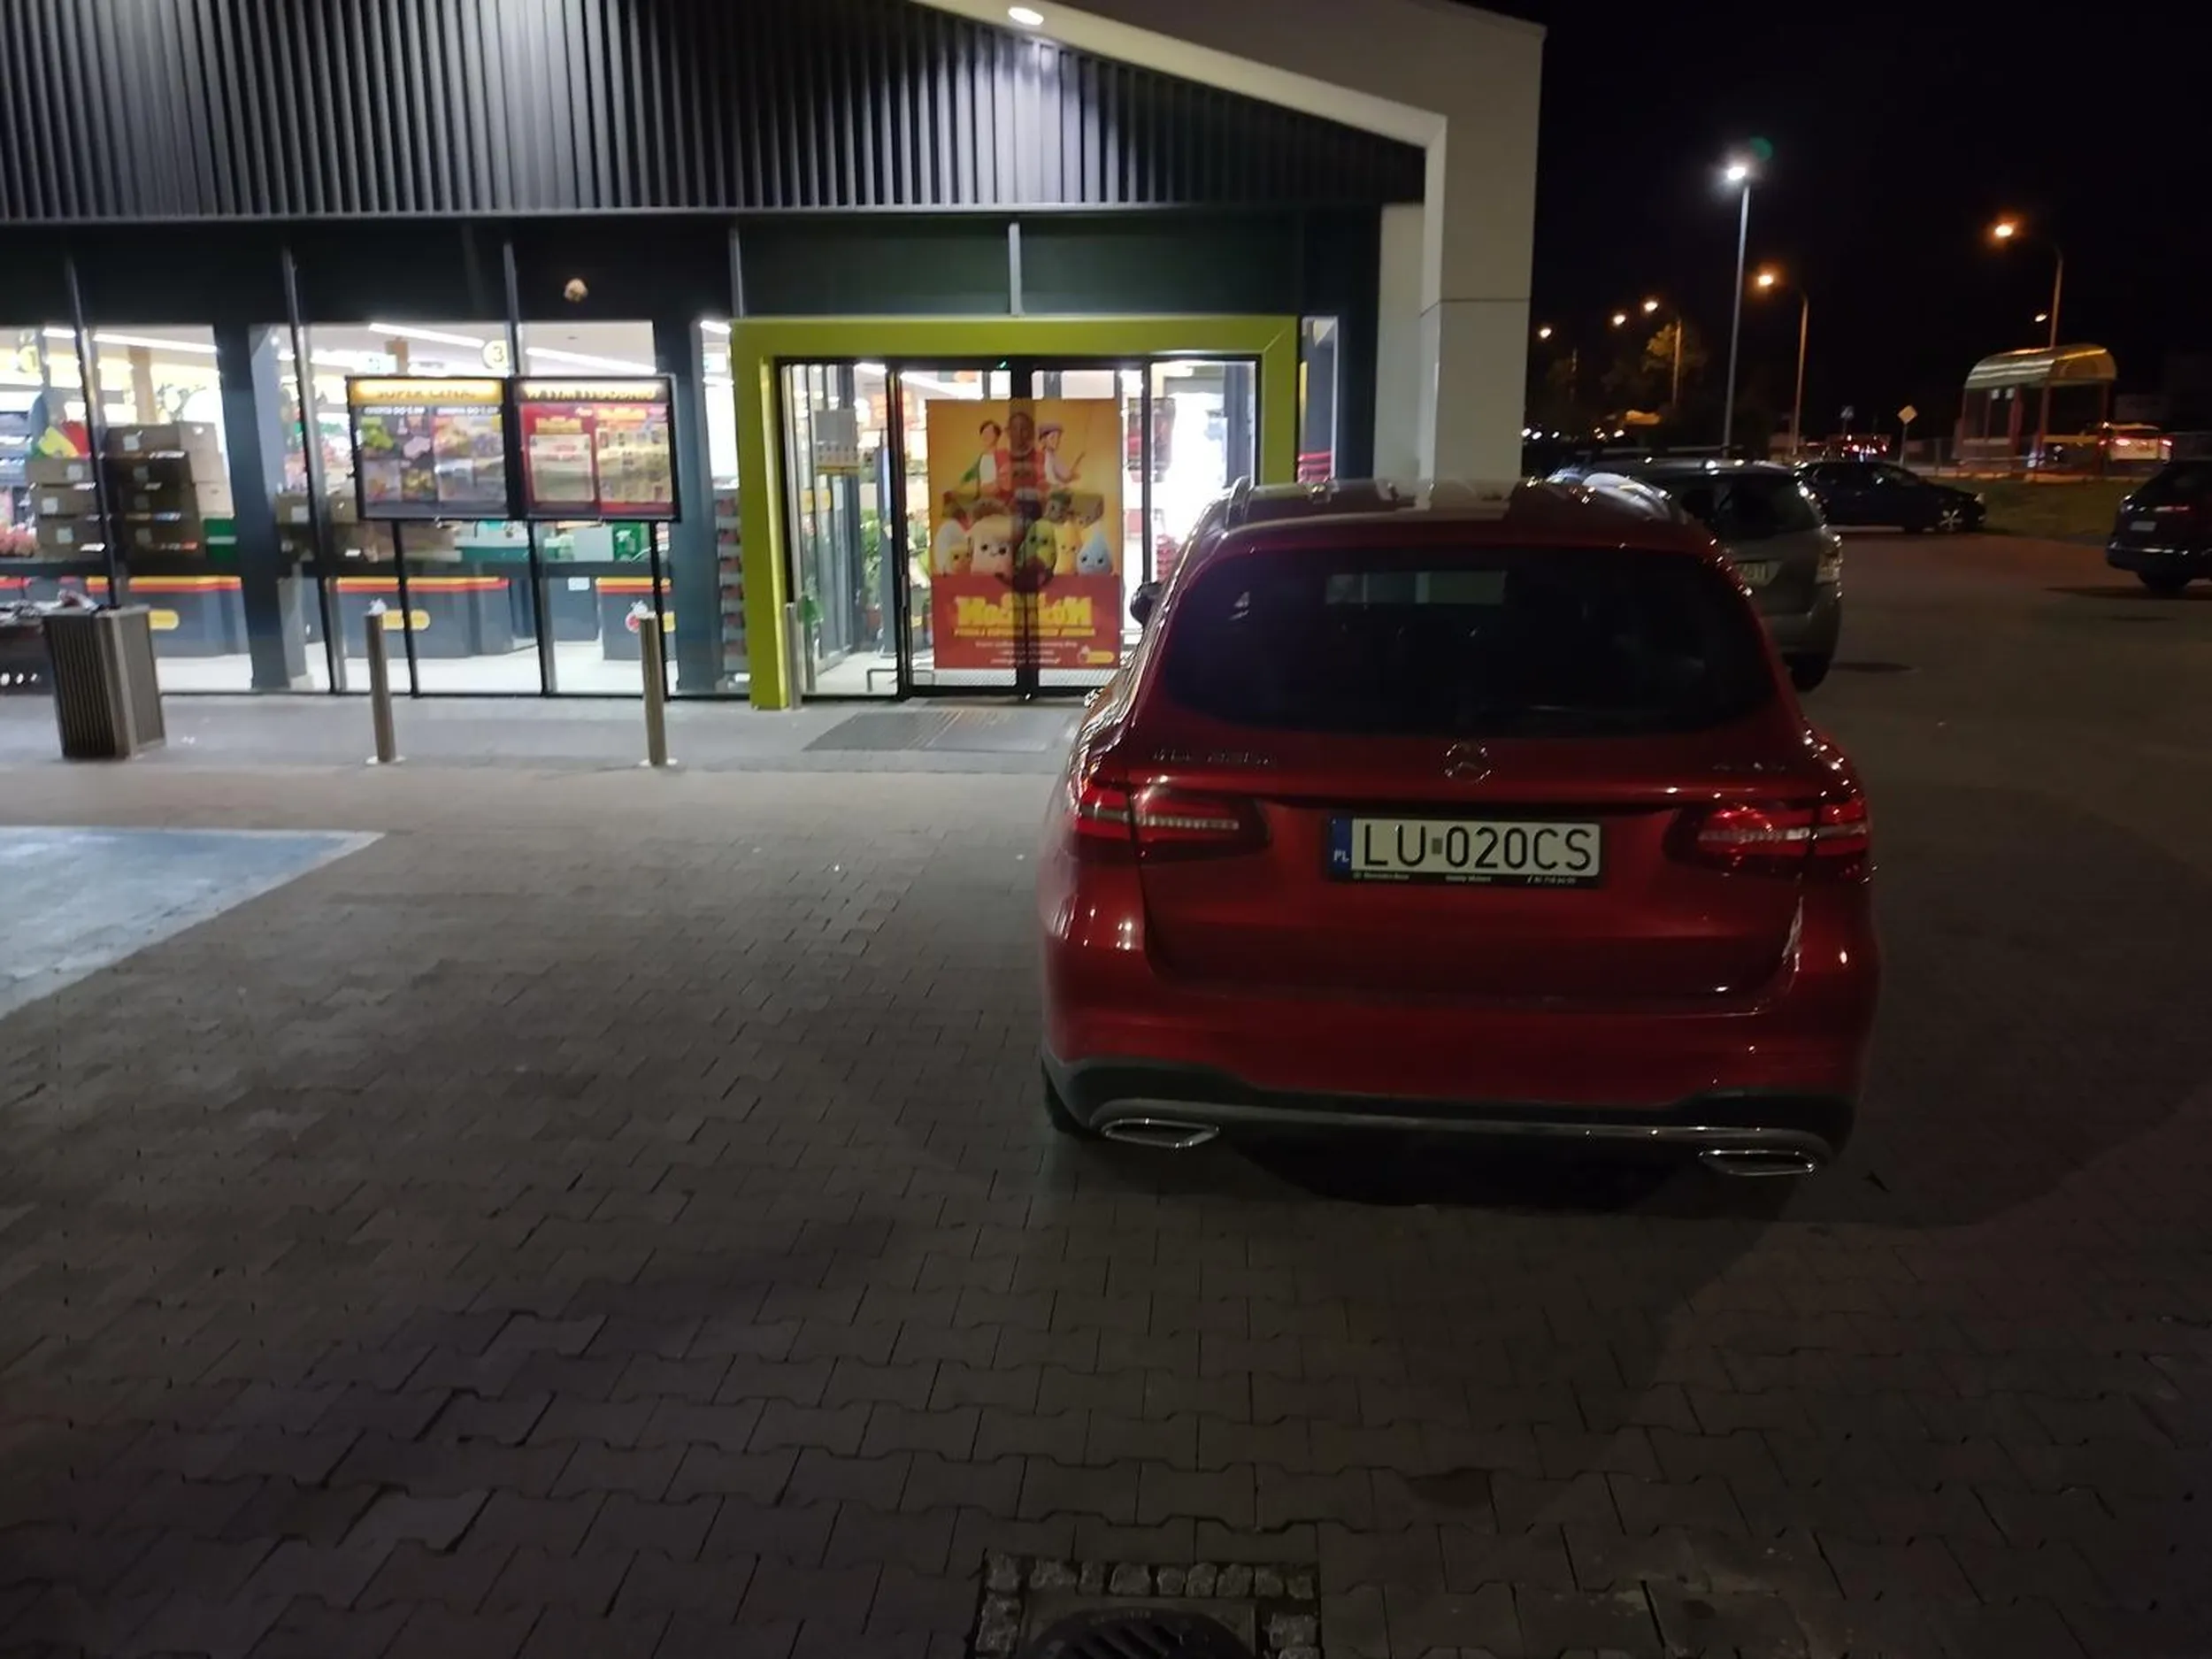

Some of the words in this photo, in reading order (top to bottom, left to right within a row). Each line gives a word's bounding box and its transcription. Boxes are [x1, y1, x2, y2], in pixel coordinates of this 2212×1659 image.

[493, 345, 504, 363] 3
[1333, 849, 1349, 863] PL
[1363, 824, 1426, 867] LU
[1445, 826, 1591, 870] 020CS
